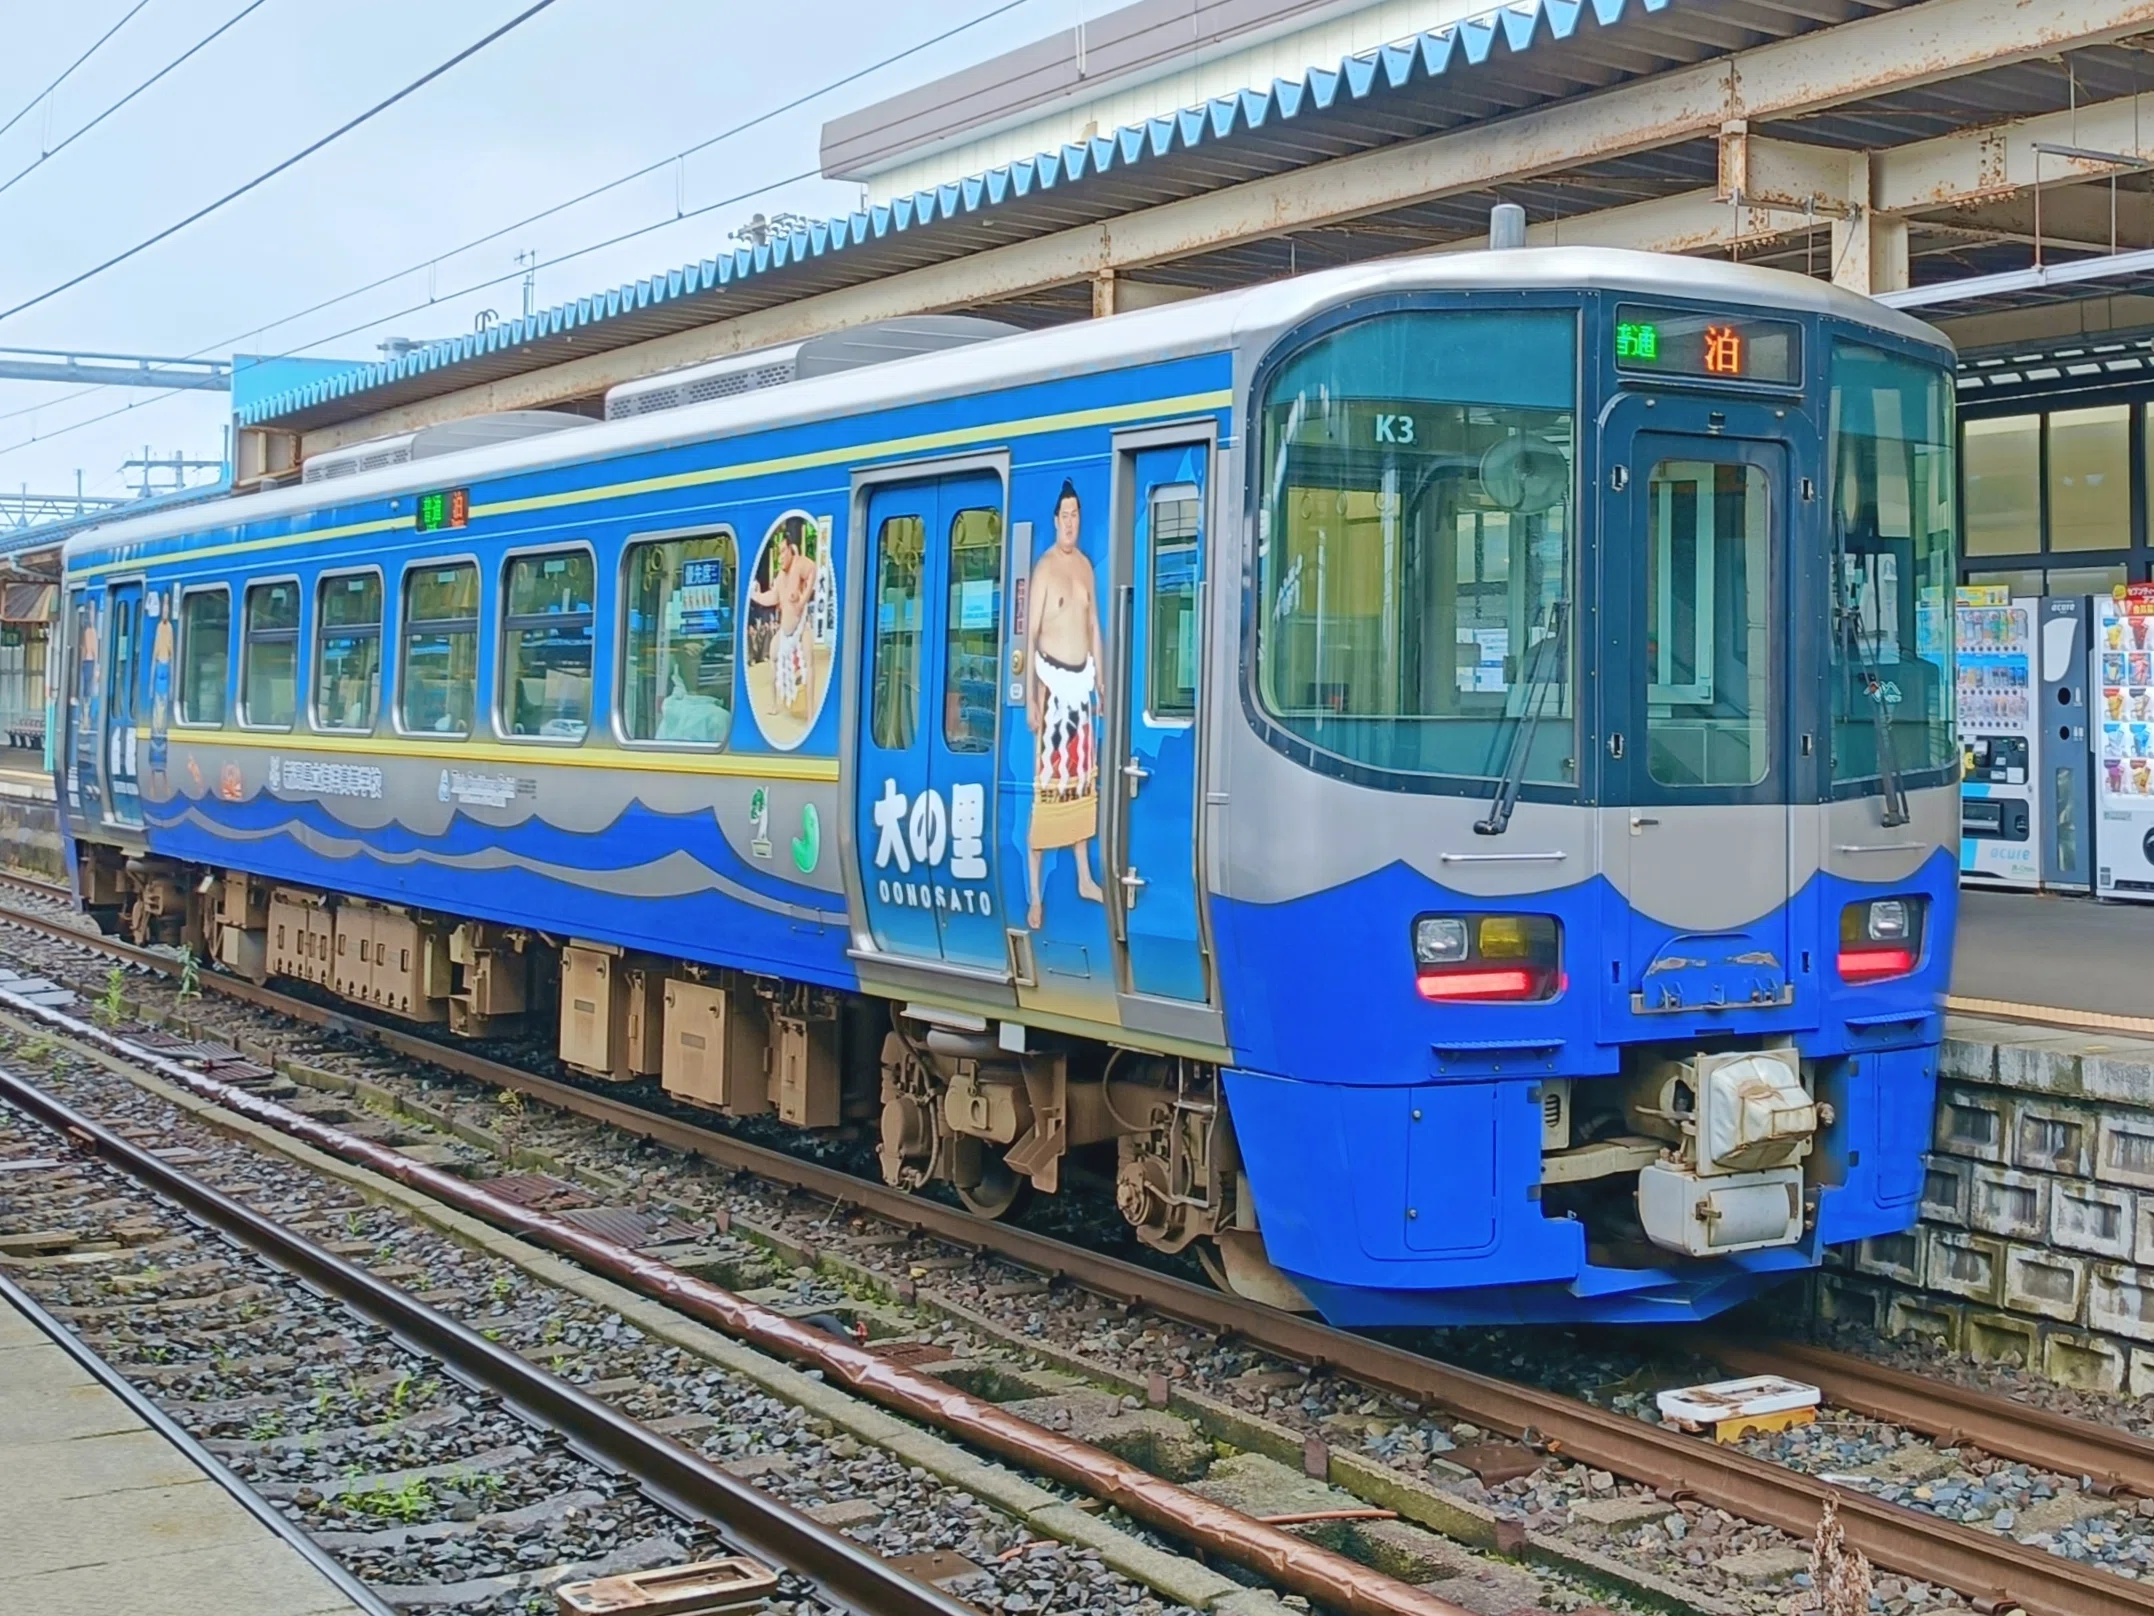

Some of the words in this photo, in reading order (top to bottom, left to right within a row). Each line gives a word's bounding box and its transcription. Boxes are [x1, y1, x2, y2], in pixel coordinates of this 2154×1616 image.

[1705, 325, 1739, 373] 泊
[1375, 414, 1414, 443] K3
[874, 778, 987, 879] 大の里
[1991, 847, 2030, 861] acure
[880, 879, 991, 916] OONOSATO
